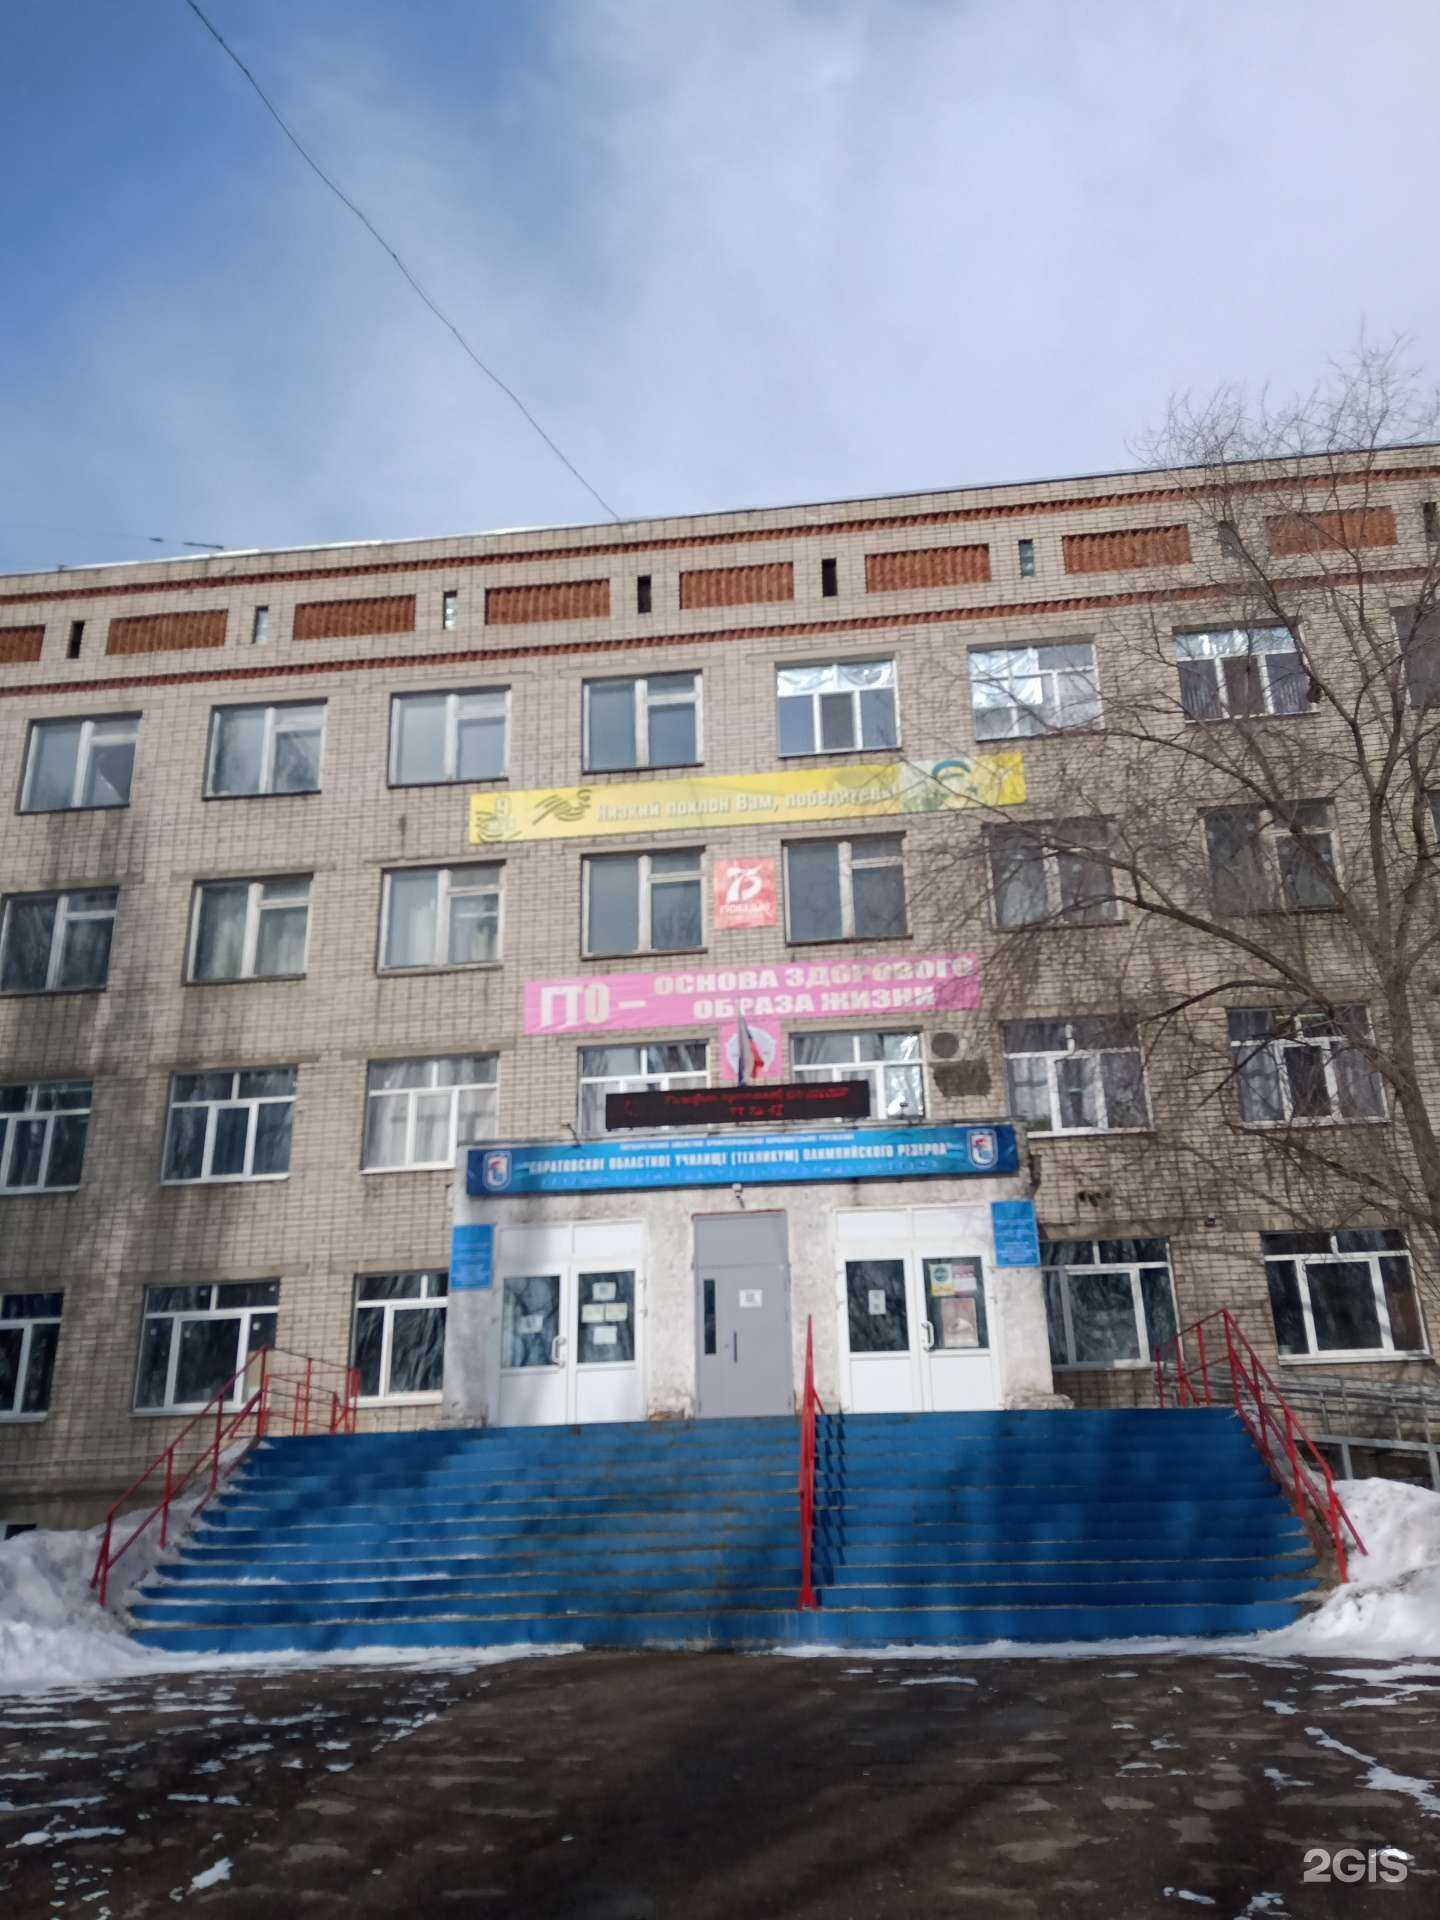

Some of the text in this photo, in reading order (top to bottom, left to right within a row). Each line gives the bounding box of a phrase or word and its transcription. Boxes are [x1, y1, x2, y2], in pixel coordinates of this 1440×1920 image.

[667, 797, 730, 817] поклон
[735, 794, 779, 813] Вам,
[654, 957, 973, 995] ОСНОВА ЗДОРОВОГО
[693, 986, 936, 1020] ОБРАЗА ЖИЗНИ
